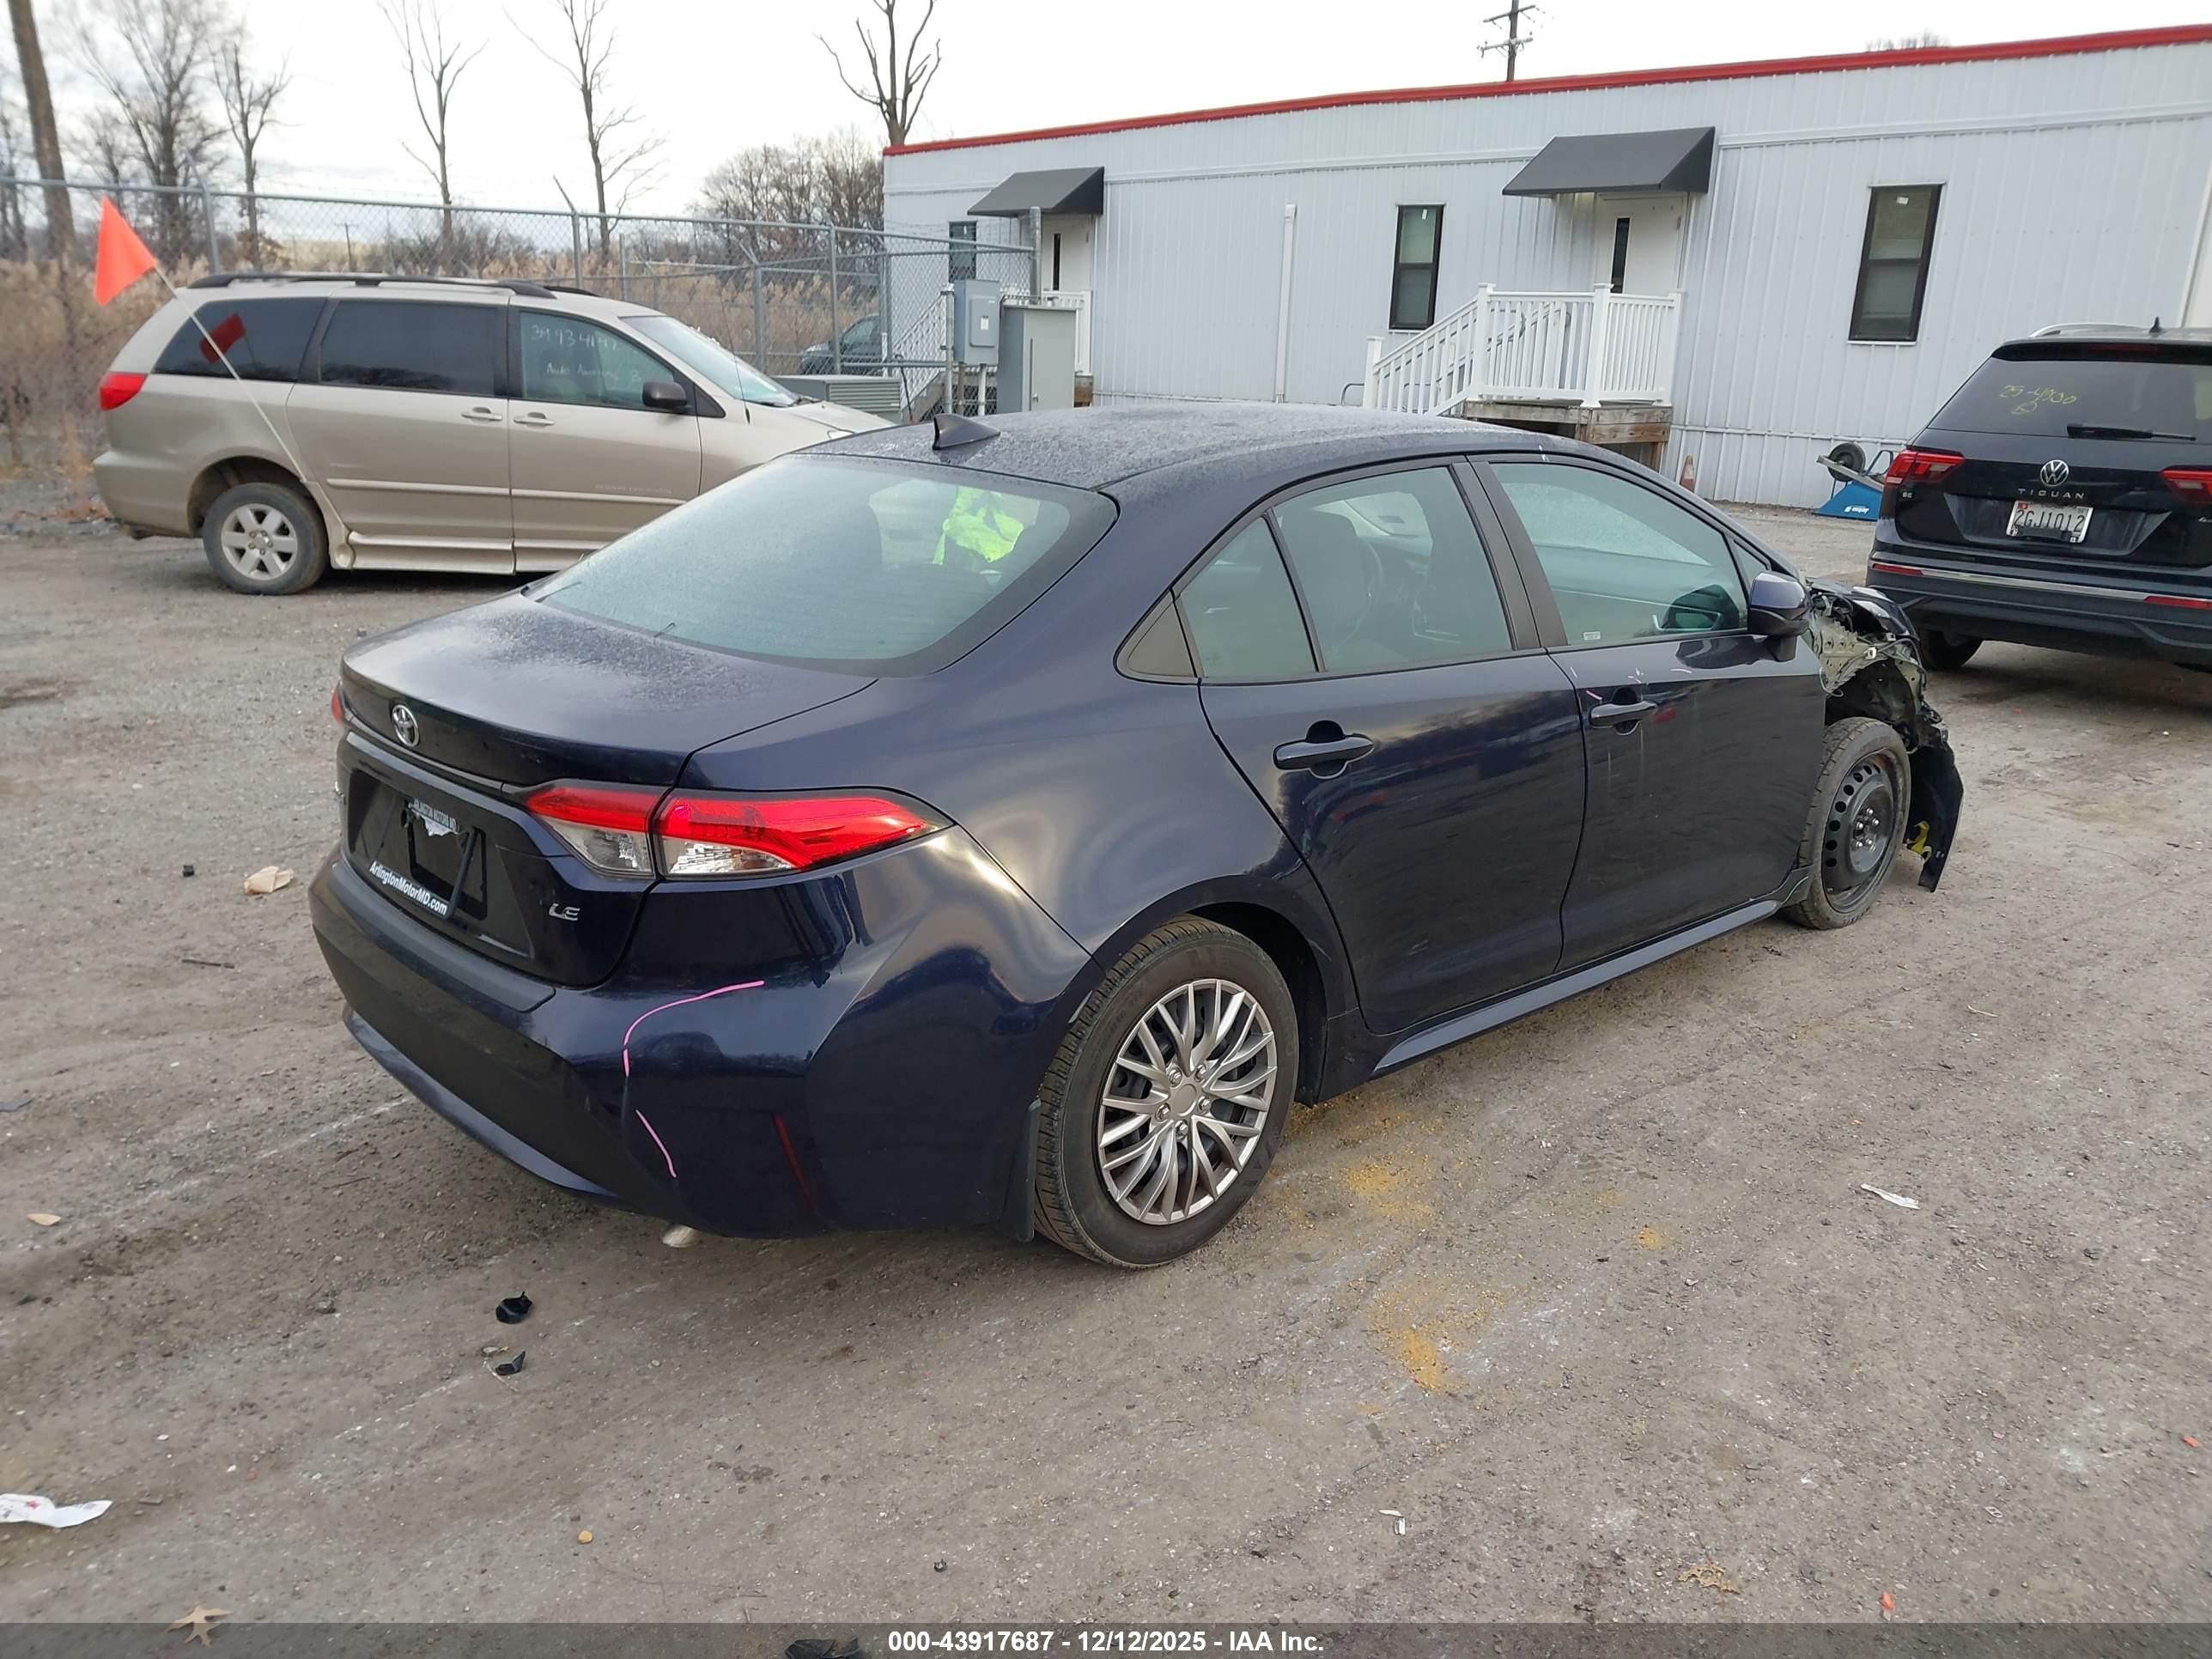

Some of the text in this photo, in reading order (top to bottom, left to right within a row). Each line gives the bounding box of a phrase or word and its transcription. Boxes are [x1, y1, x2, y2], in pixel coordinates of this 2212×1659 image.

[2018, 488, 2085, 500] TIGUAN
[2013, 509, 2086, 532] 2GJ1012
[368, 860, 448, 915] ArlingtonMotorMD.com
[548, 902, 580, 921] LE
